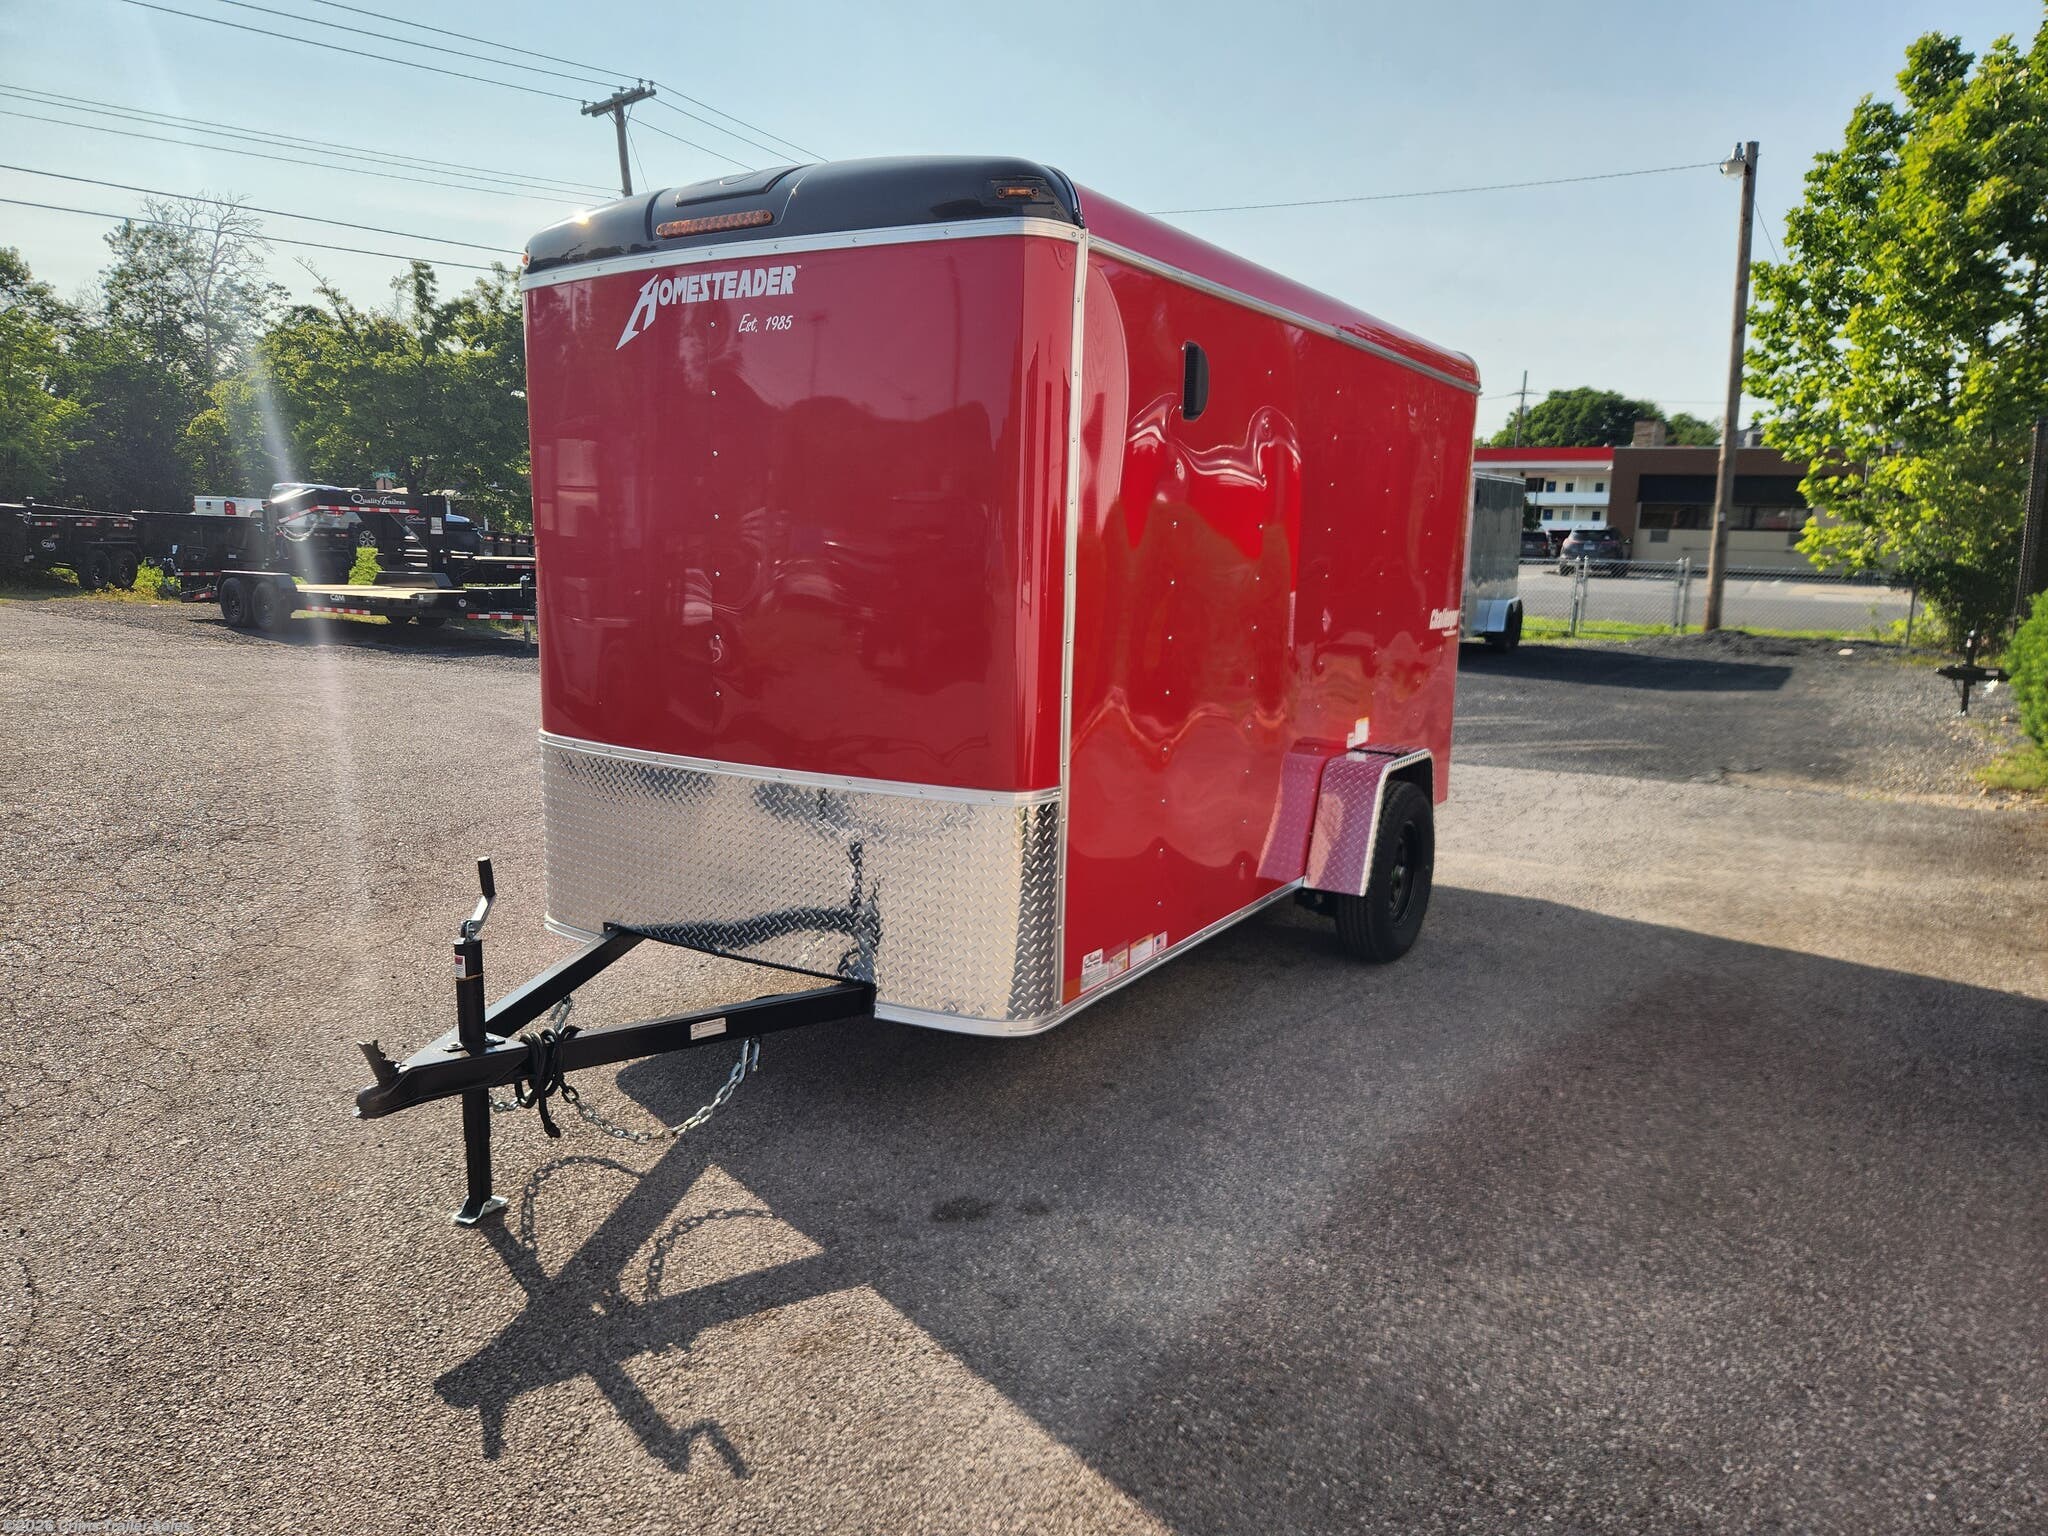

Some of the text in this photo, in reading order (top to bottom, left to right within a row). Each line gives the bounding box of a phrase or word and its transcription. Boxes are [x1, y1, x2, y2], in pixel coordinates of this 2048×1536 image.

[738, 313, 794, 333] Est. 1985
[351, 493, 406, 506] Quality Trailers
